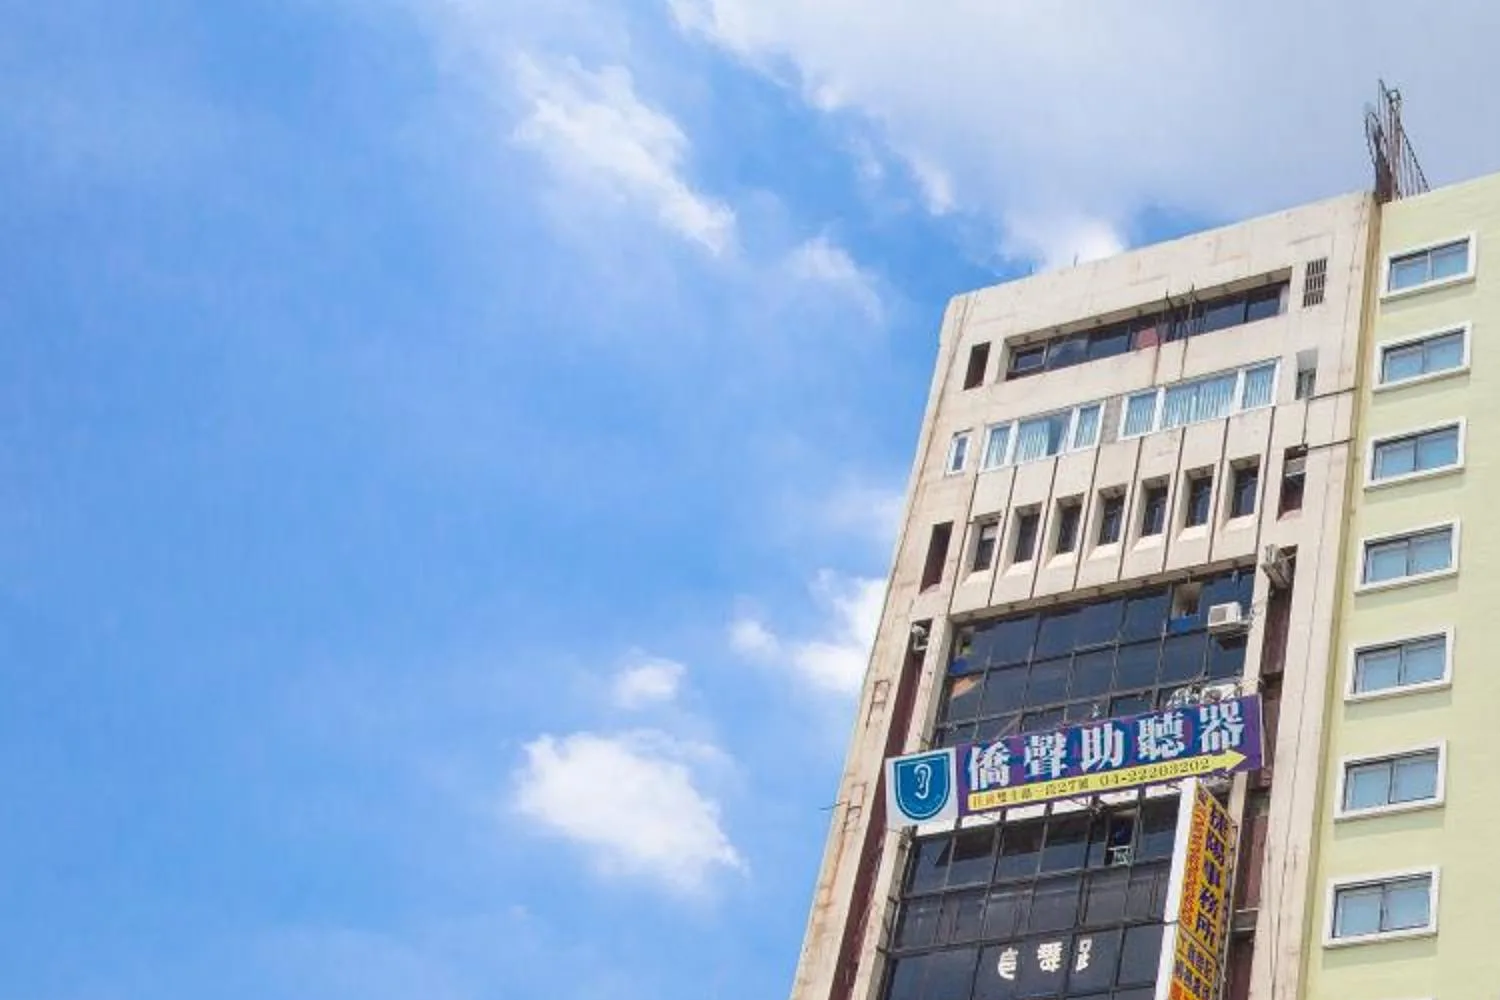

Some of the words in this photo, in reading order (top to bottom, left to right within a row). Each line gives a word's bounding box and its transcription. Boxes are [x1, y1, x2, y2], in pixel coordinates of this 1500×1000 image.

[969, 700, 1244, 791] 僑聲助聽器
